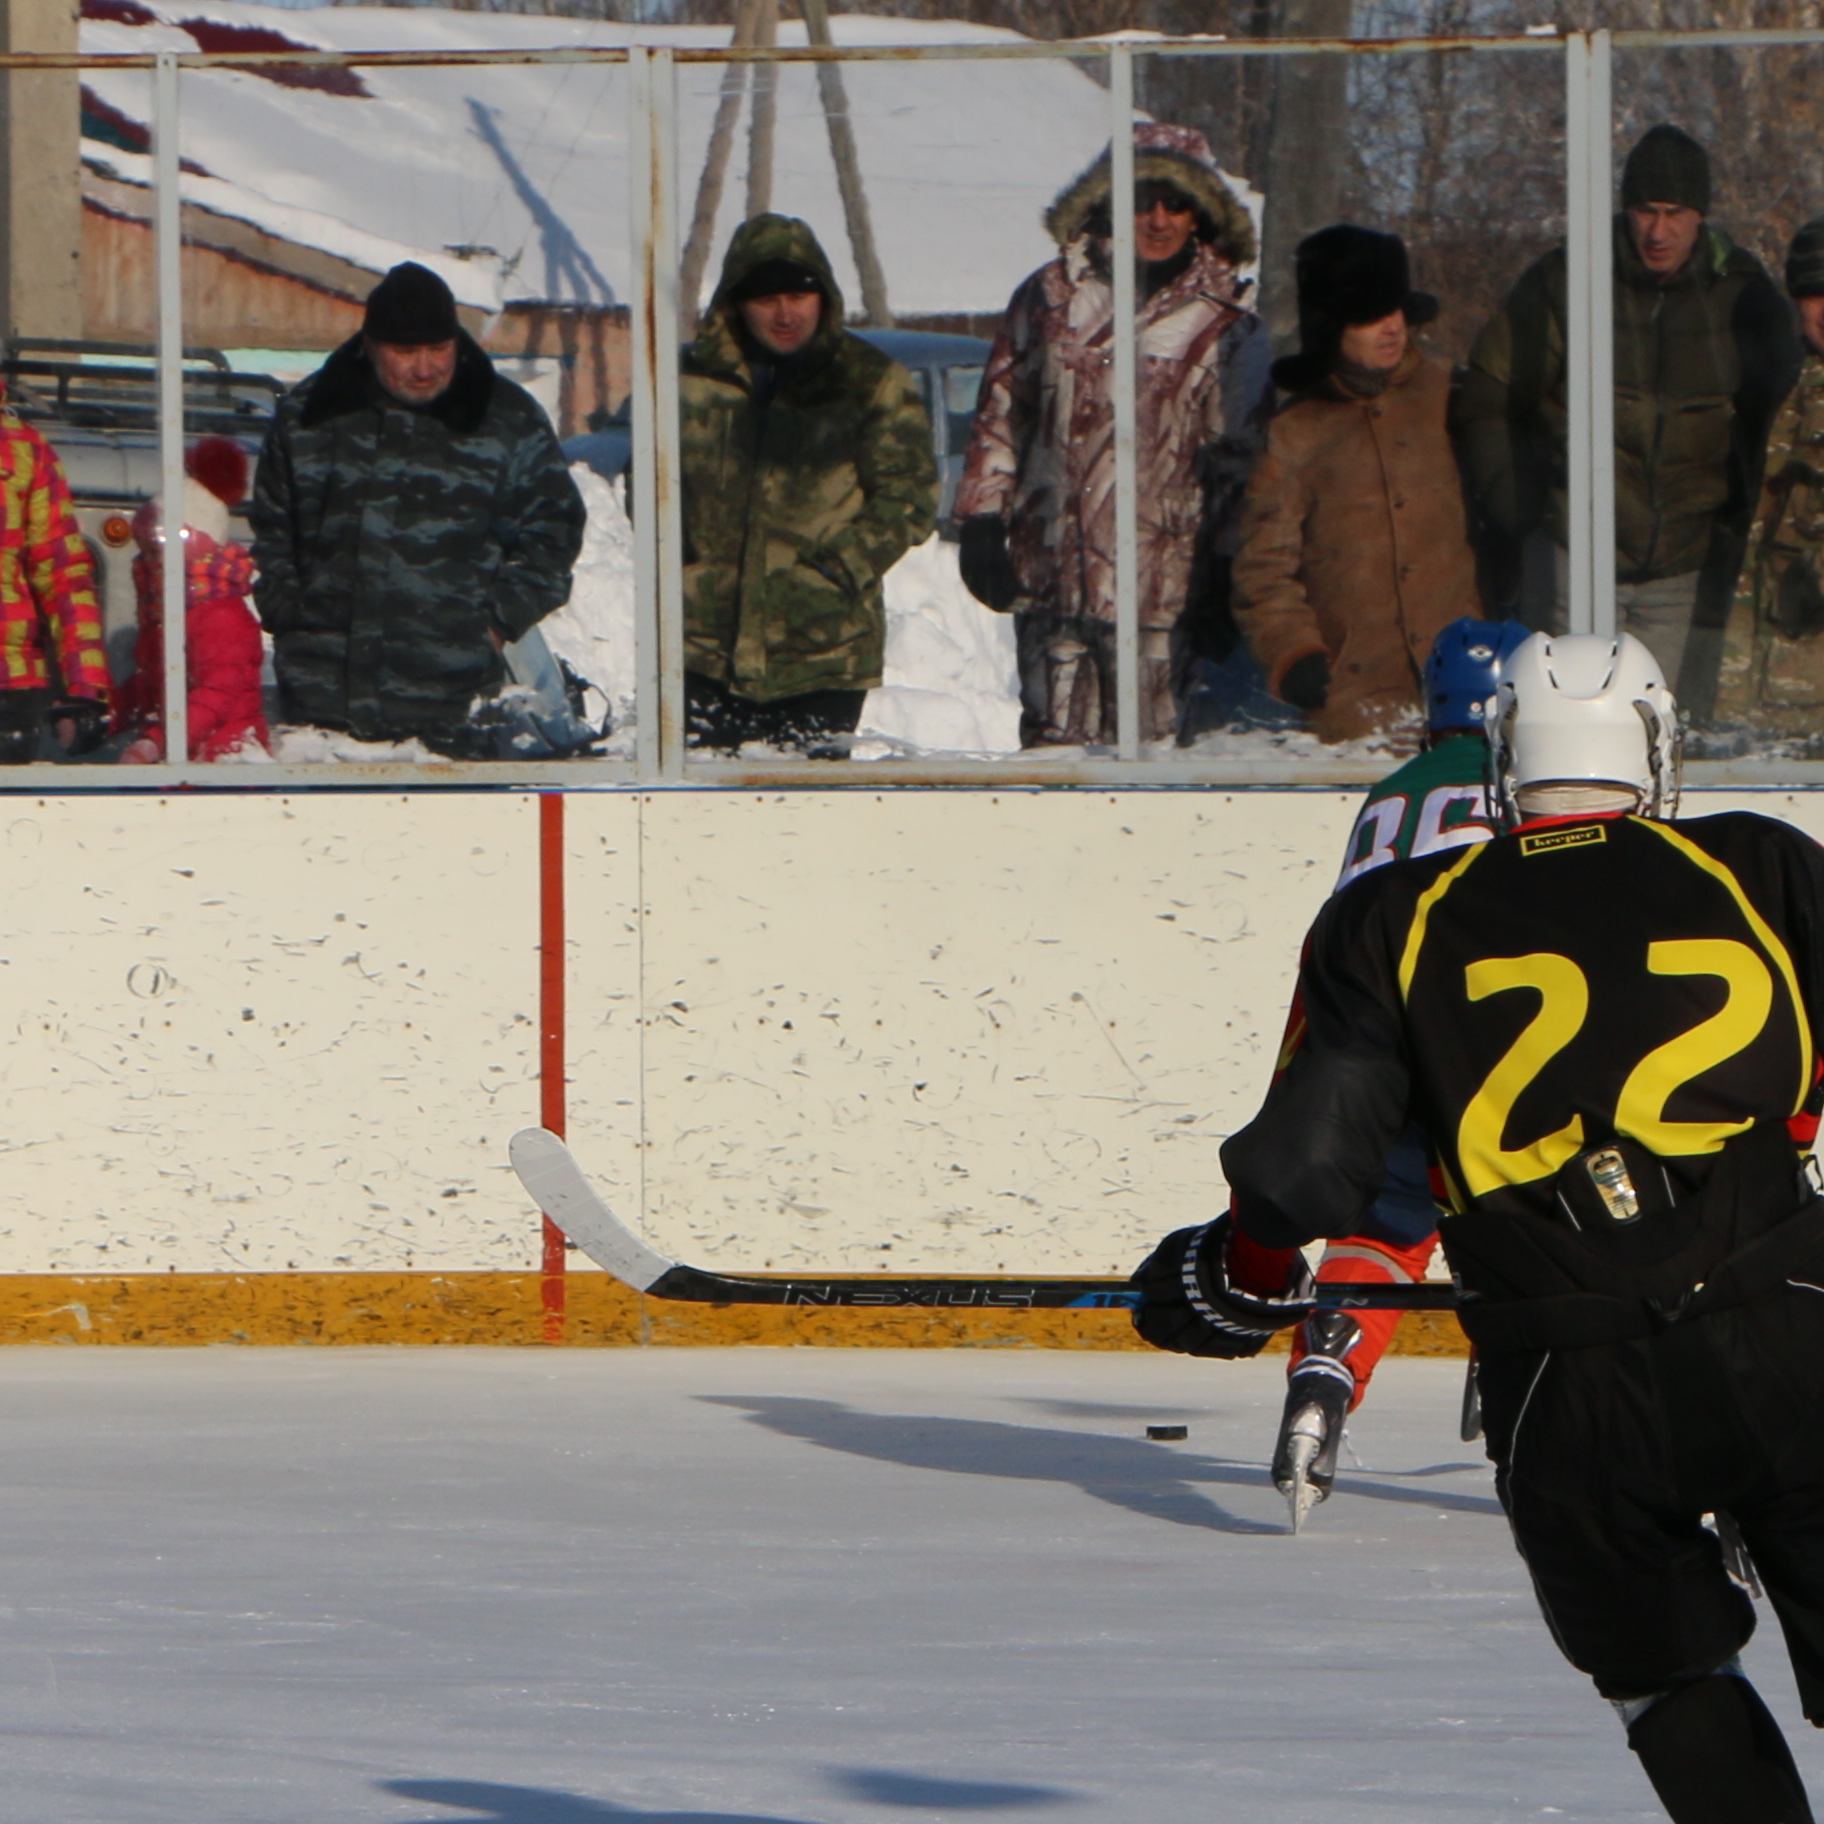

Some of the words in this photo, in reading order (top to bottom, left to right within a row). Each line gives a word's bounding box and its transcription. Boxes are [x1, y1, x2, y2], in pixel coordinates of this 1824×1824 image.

[1533, 829, 1595, 848] keeper
[1457, 938, 1775, 1198] 22
[782, 1284, 1036, 1309] NEXUS
